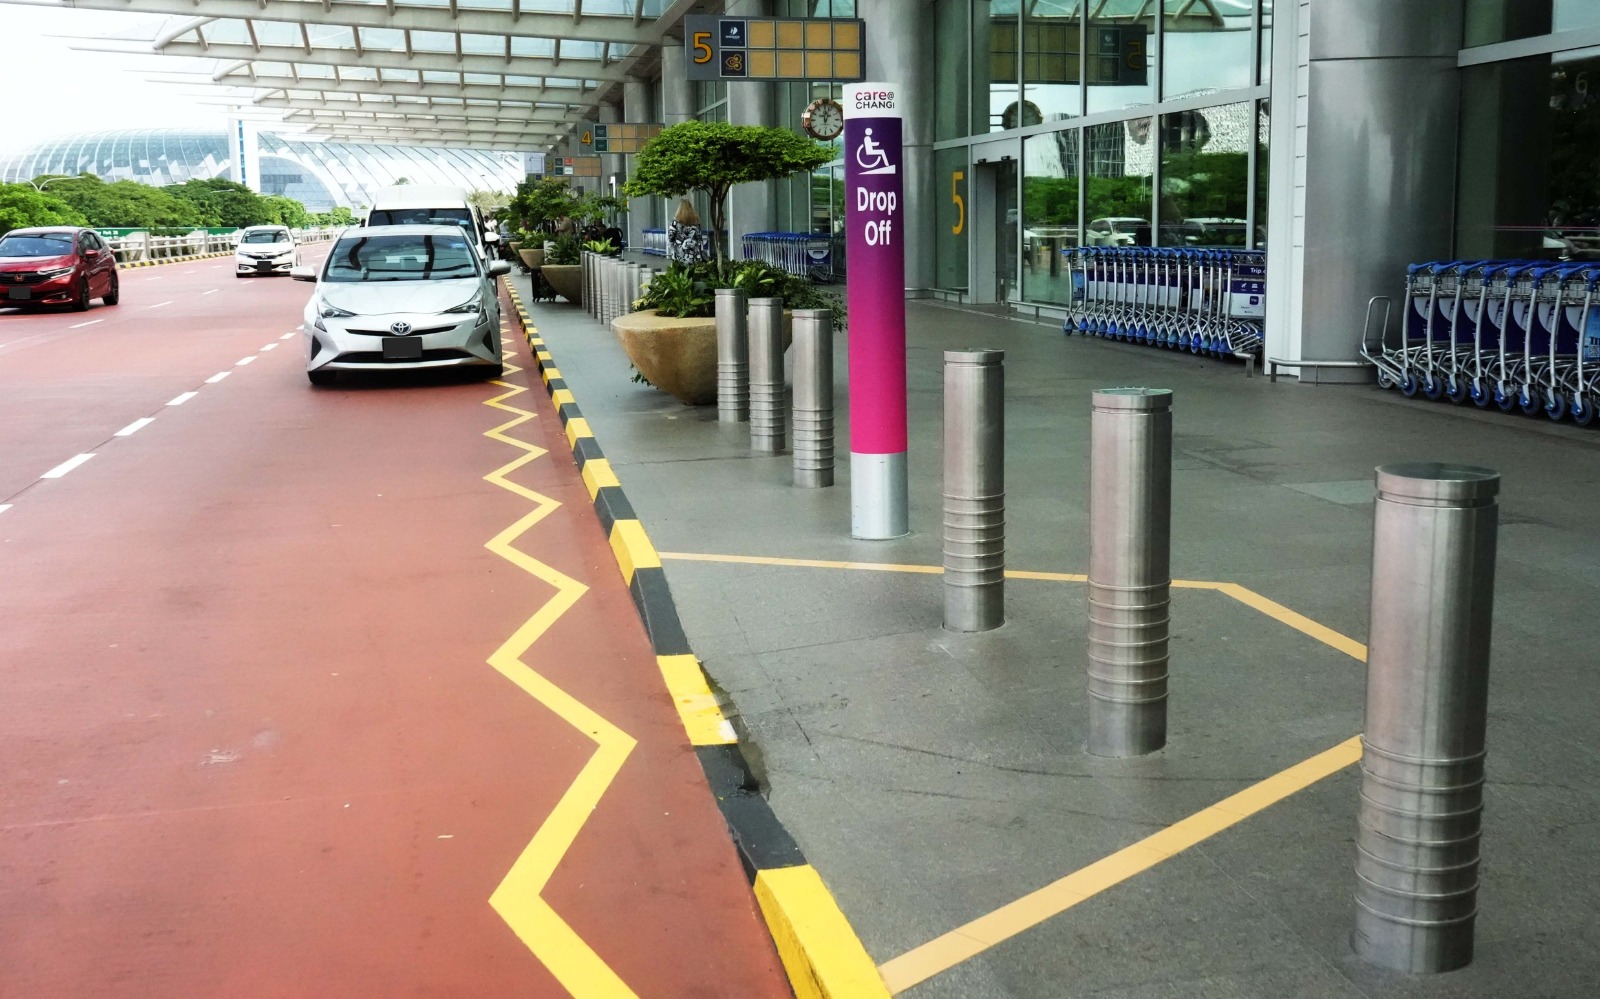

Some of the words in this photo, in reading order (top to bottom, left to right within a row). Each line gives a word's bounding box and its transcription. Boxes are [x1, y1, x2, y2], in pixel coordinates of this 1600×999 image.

[694, 32, 712, 63] 5
[855, 91, 895, 101] care@
[855, 101, 895, 109] CHANGI
[581, 129, 593, 146] 4
[857, 186, 897, 216] Drop
[952, 171, 964, 235] 5
[864, 219, 892, 246] Off
